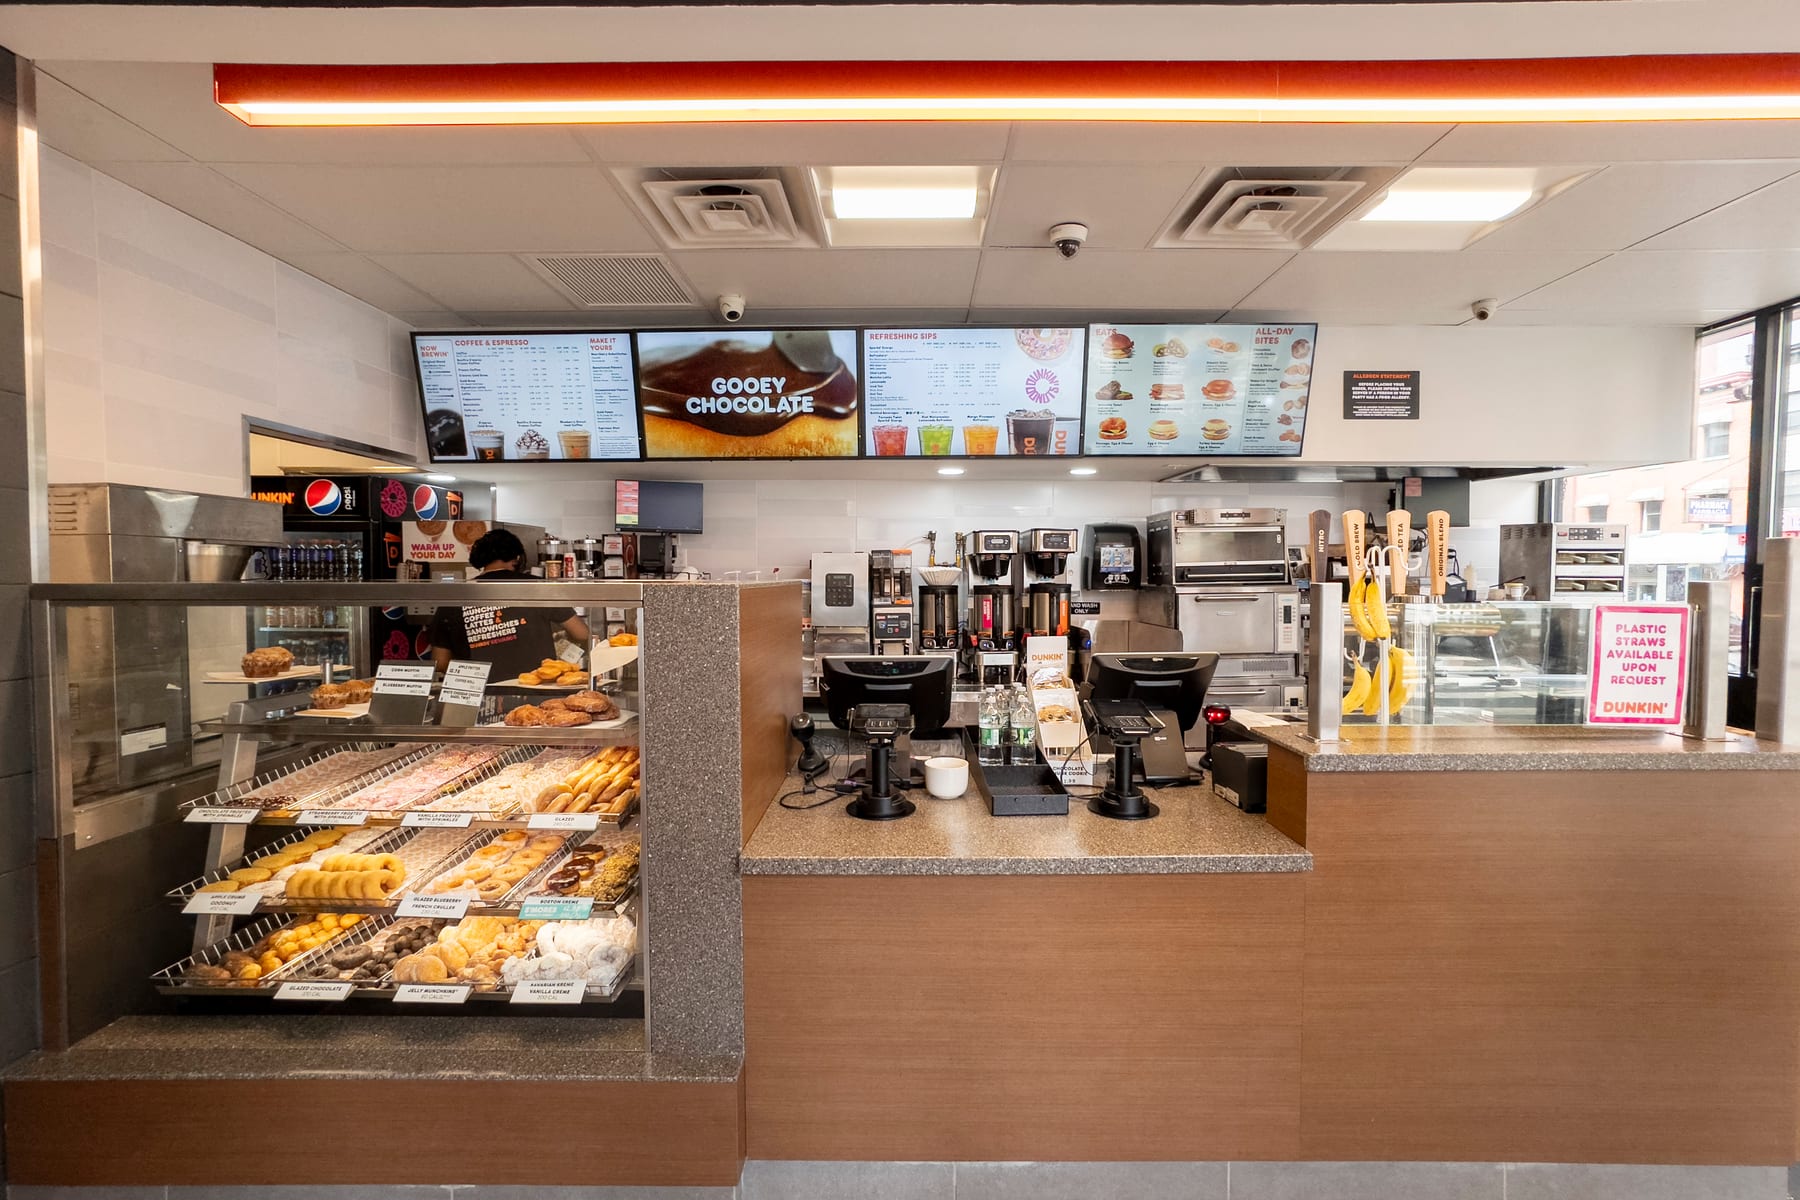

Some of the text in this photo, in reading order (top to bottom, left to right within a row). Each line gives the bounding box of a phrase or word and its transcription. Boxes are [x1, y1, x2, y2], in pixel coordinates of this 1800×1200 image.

[712, 377, 786, 394] GOOEY
[686, 396, 814, 414] CHOCOLATE
[250, 492, 294, 504] UNKIN'
[343, 487, 352, 510] pepsi
[464, 612, 495, 623] COFFEE
[465, 619, 494, 630] LATTES
[466, 619, 519, 636] SANDWICHES
[1616, 624, 1666, 633] PLASTIC
[467, 627, 516, 643] REFRESHERS
[1616, 637, 1665, 647] STRAWS
[1607, 650, 1673, 659] AVAILABLE
[1622, 663, 1656, 672] UPON
[1611, 676, 1666, 685] REQUEST
[1604, 701, 1668, 714] DUNKIN'
